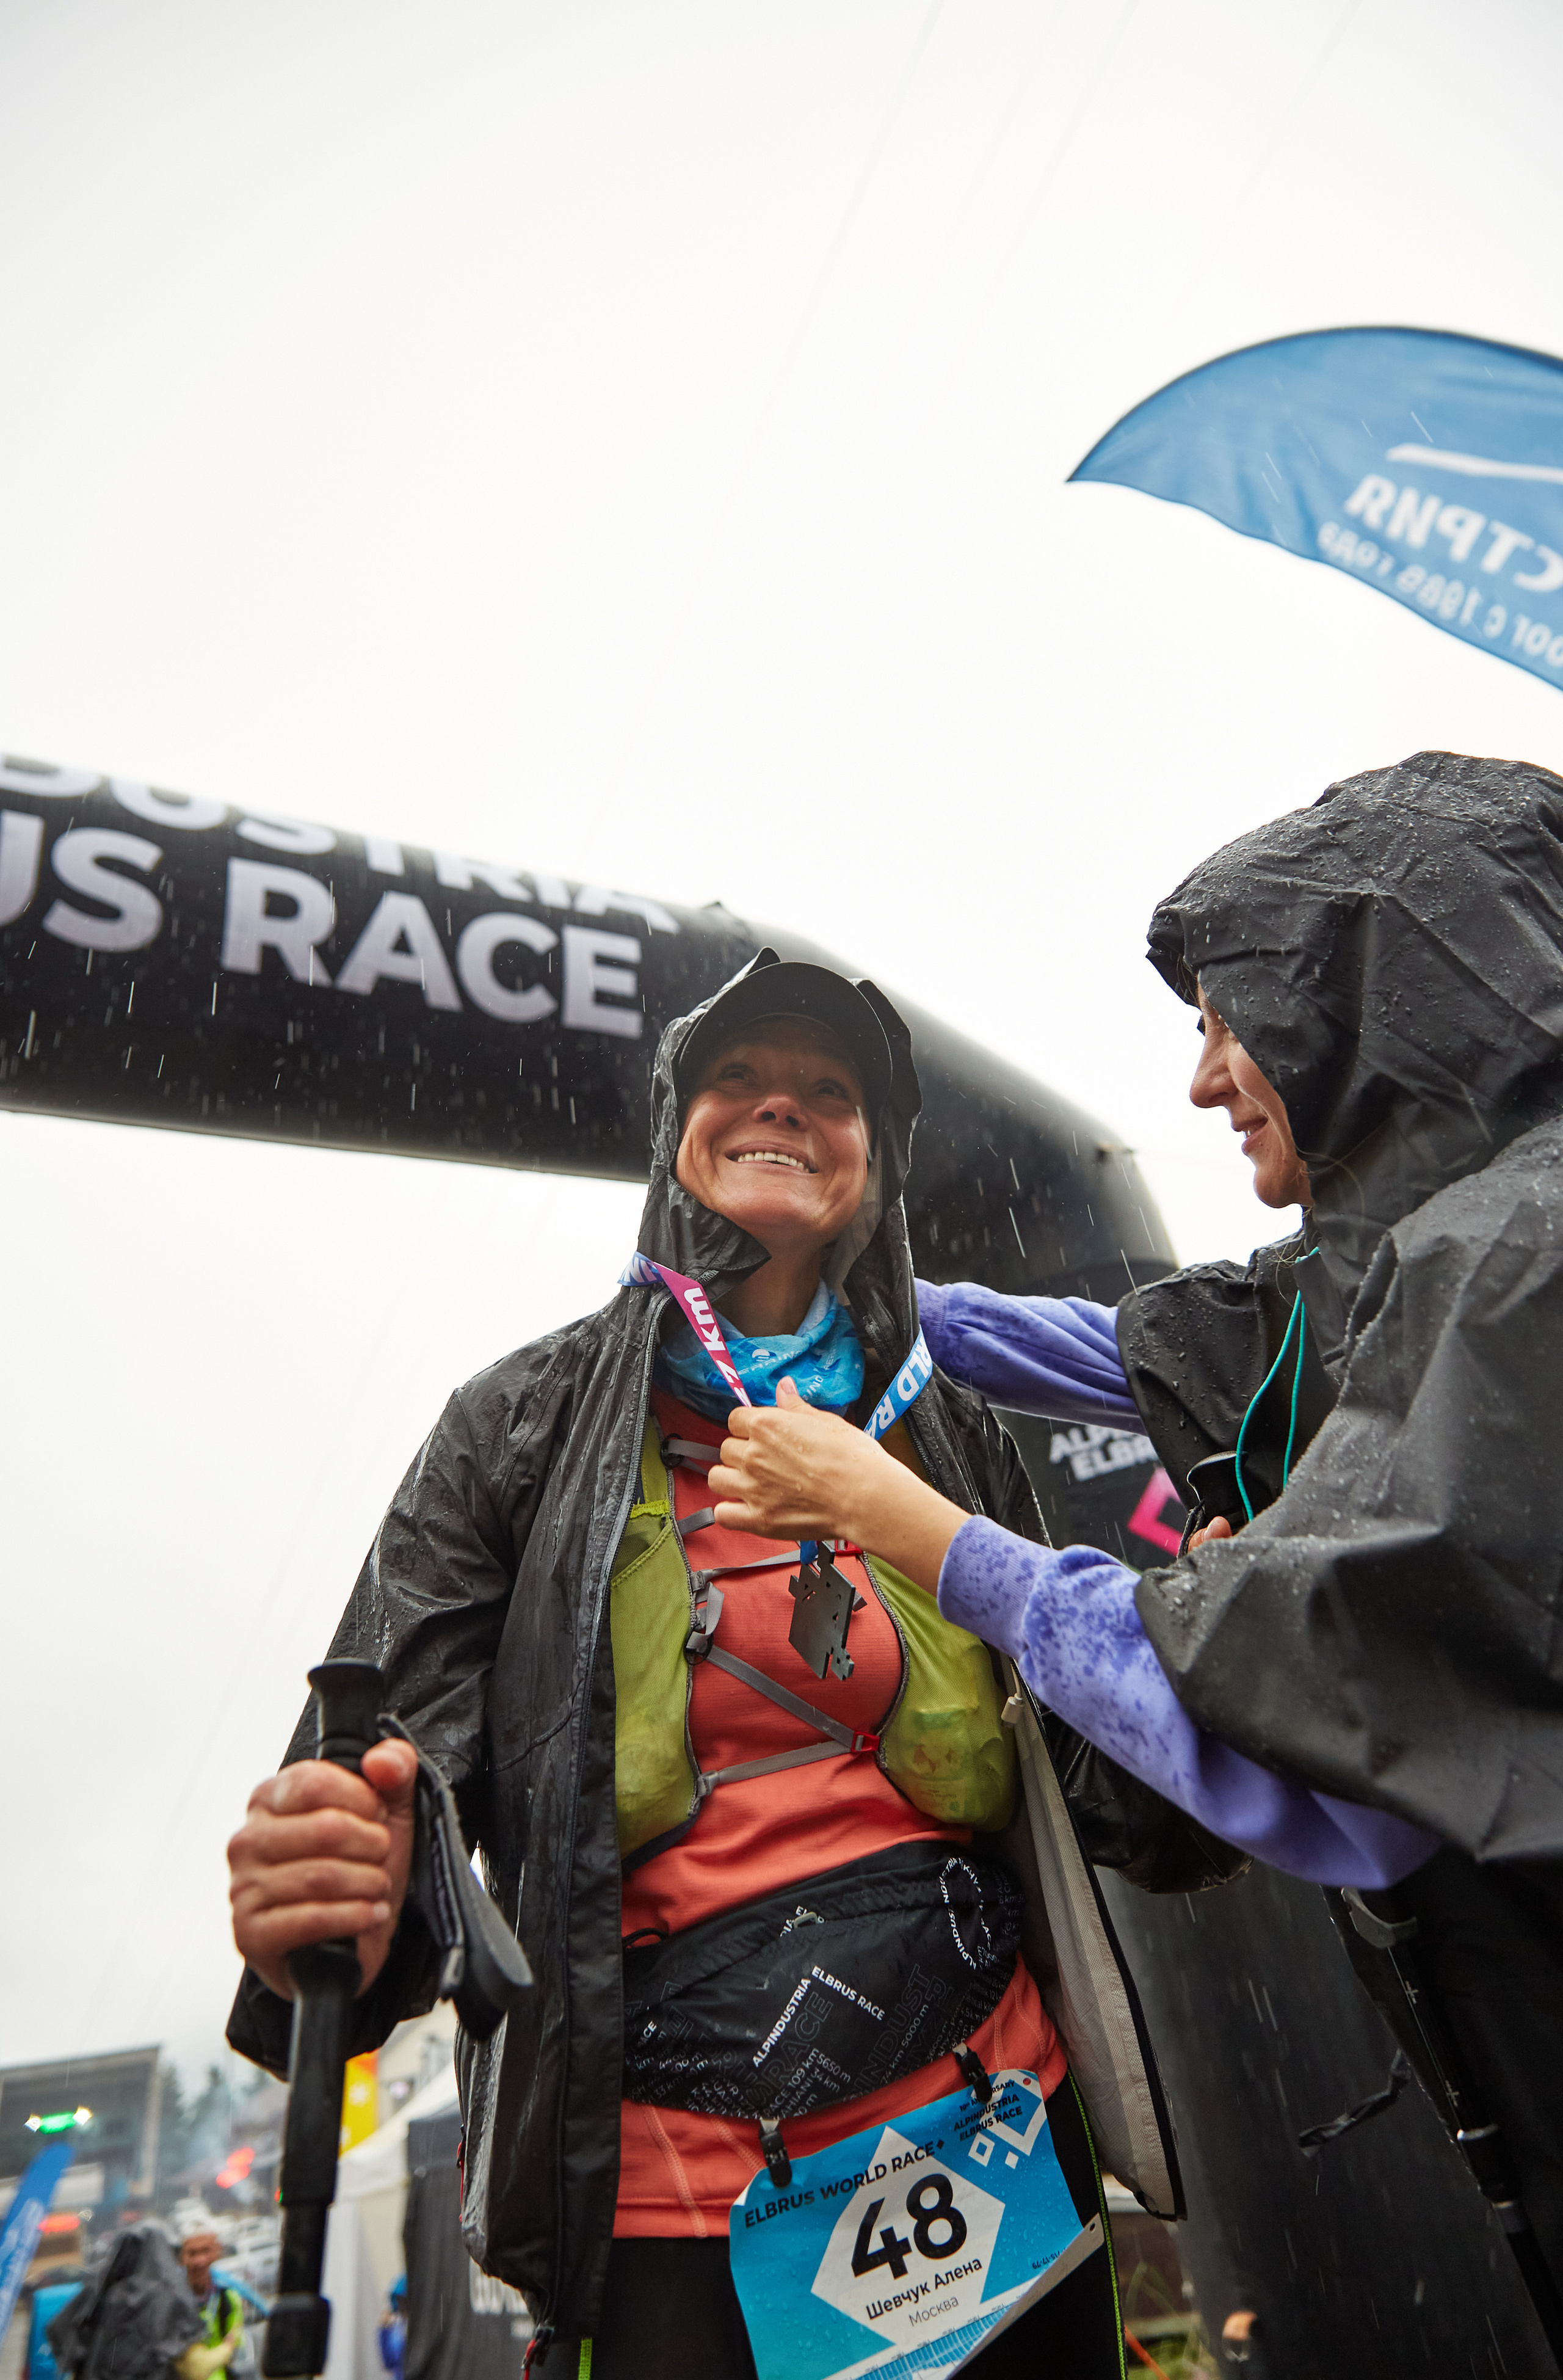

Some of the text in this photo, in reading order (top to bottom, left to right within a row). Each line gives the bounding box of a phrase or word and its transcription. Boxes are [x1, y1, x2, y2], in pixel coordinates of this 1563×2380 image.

[220, 856, 642, 1039] RACE
[684, 1286, 727, 1352] km
[752, 1978, 811, 2068] ALPINDUSTRIA
[811, 1965, 885, 2021] ELBRUS RACE
[788, 2067, 805, 2088] 109
[802, 2048, 819, 2069] km
[816, 2053, 841, 2076] 5650
[840, 2072, 852, 2084] m
[889, 2050, 905, 2069] km
[901, 2017, 921, 2048] 5000
[919, 2004, 929, 2018] m
[954, 2094, 1020, 2132] ALPINDUSTRIA
[959, 2106, 1023, 2142] ELBRUS RACE
[745, 2140, 936, 2229] ELBRUS WORLD RACE
[850, 2173, 968, 2280] 48
[866, 2257, 982, 2320] Шевчук Алена
[908, 2296, 960, 2327] Москва
